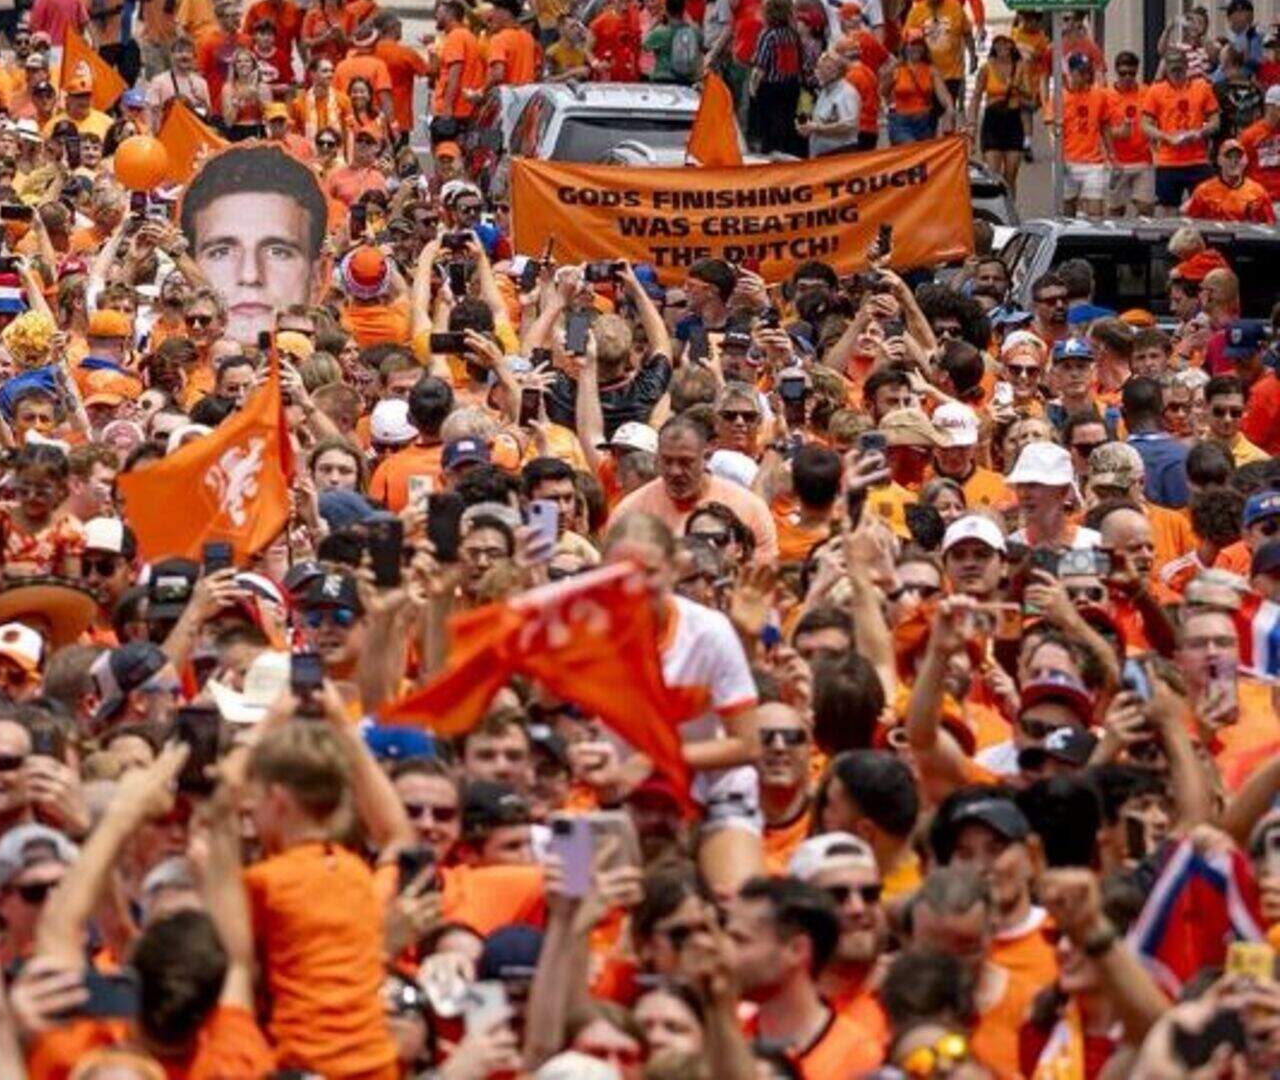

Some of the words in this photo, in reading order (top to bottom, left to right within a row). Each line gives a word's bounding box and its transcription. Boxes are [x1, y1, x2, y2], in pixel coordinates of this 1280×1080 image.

[556, 186, 641, 208] GODS
[652, 184, 813, 210] FINISHING
[823, 164, 929, 199] TOUCH
[616, 216, 690, 238] WAS
[700, 203, 859, 236] CREATING
[648, 245, 710, 268] THE
[722, 234, 840, 263] DUTCH!
